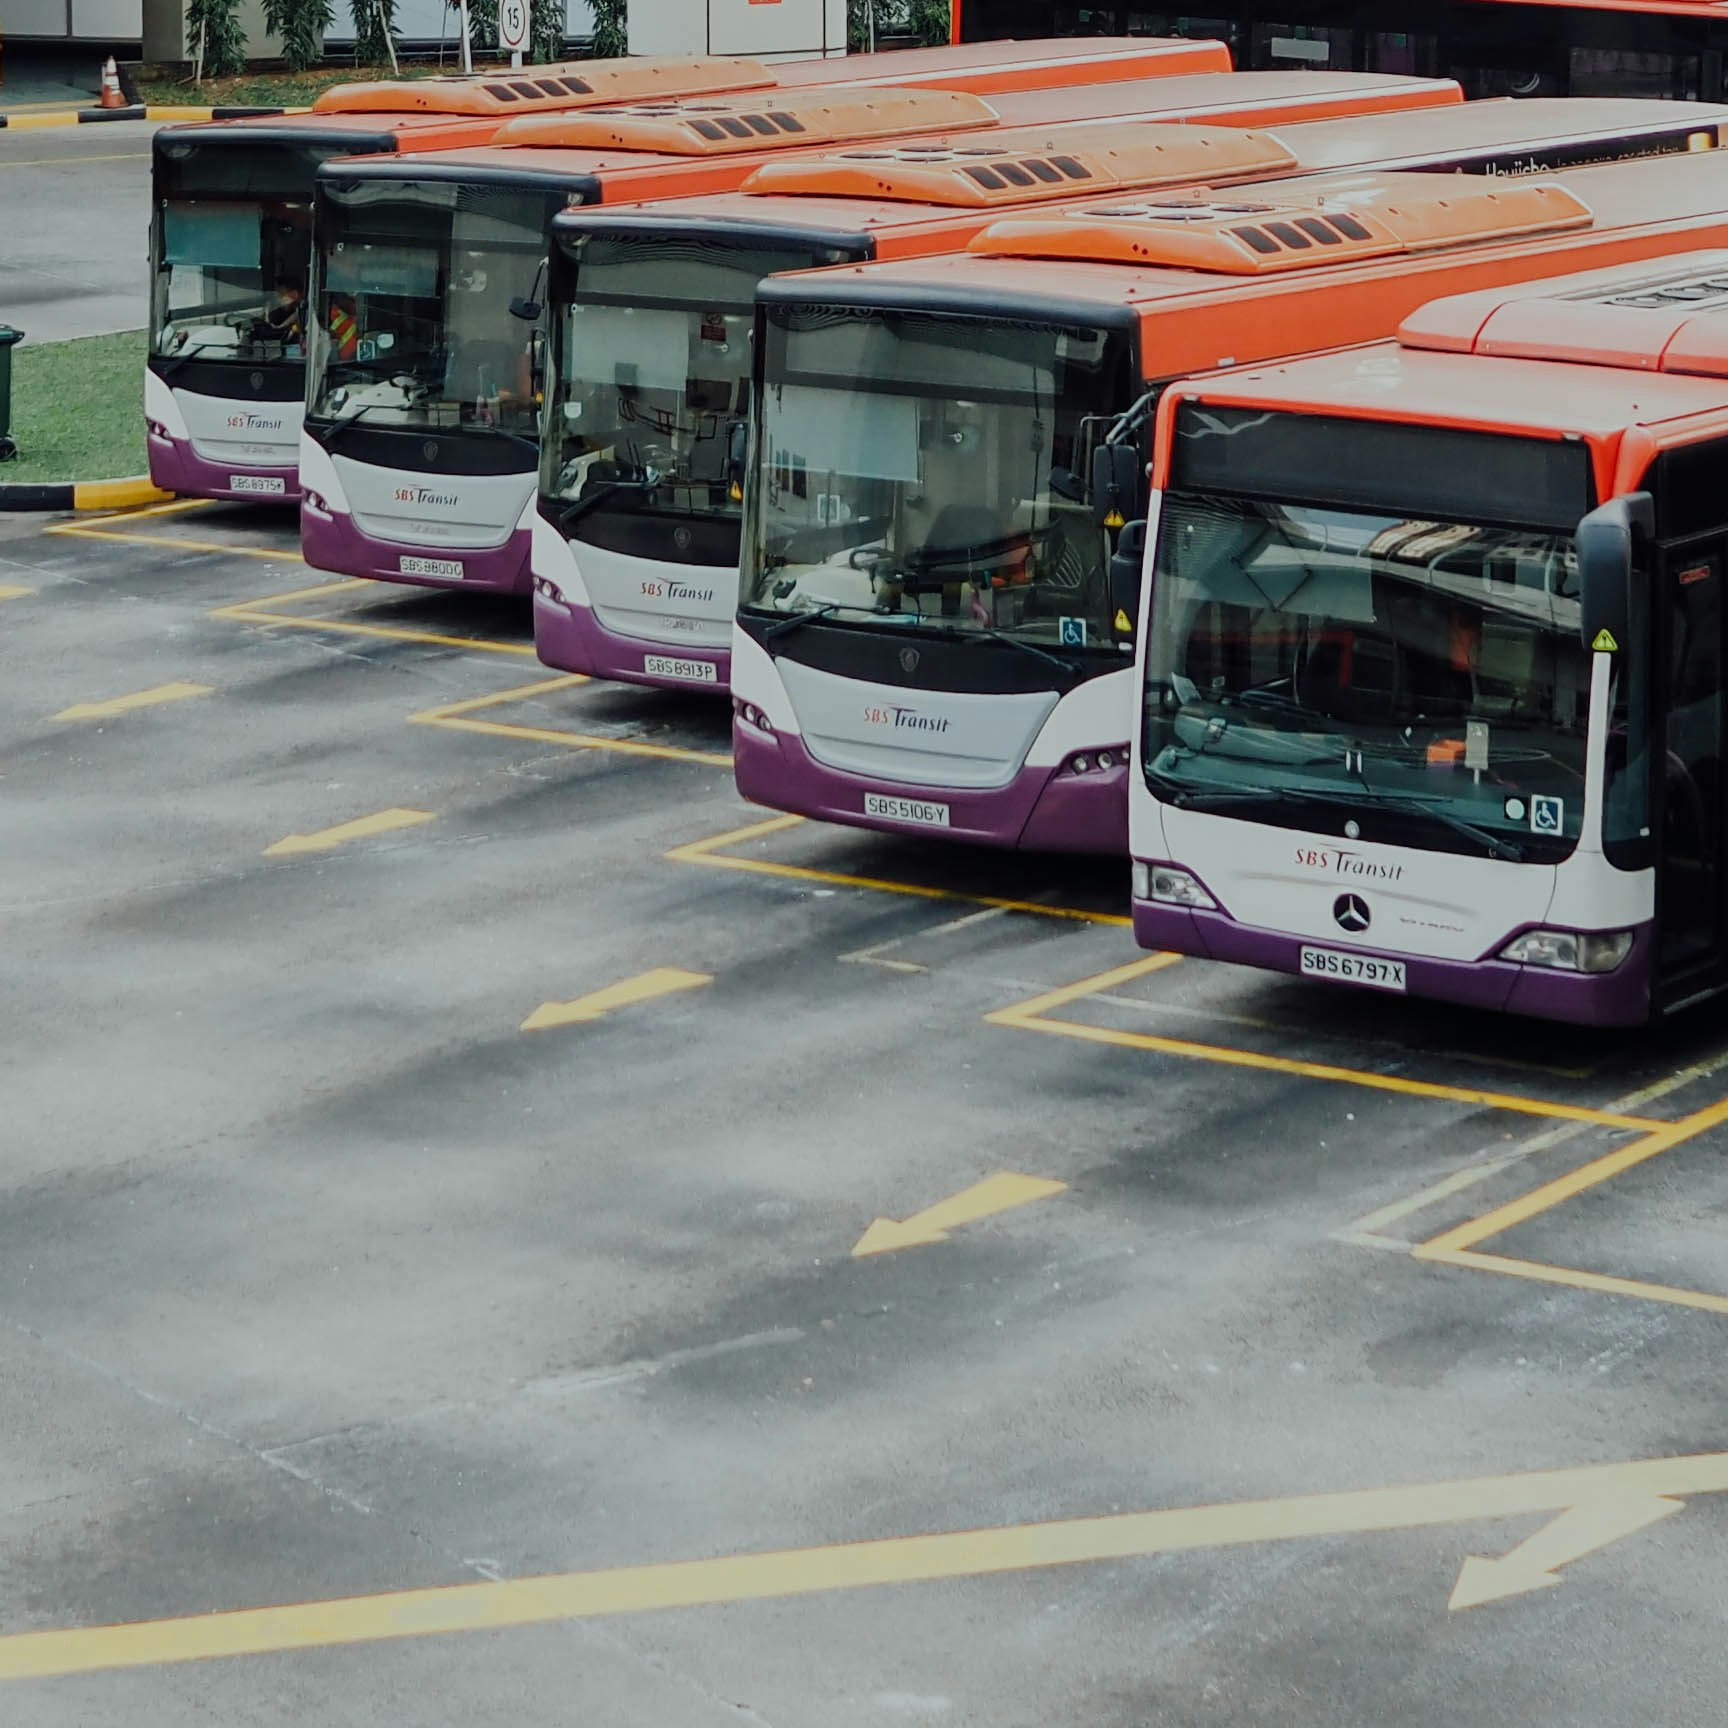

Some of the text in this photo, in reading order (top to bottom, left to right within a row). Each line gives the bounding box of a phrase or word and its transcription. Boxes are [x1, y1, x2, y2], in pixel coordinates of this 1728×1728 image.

[507, 6, 519, 29] 15
[245, 414, 284, 429] Transit
[394, 488, 460, 505] SBS Transit
[641, 581, 715, 601] SBS Transit
[648, 658, 712, 679] SBS8913P
[864, 706, 952, 733] SBS Transit
[869, 797, 944, 823] SBS5106Y
[1295, 848, 1404, 880] SBS Transit
[1303, 952, 1403, 983] SBS6797X
